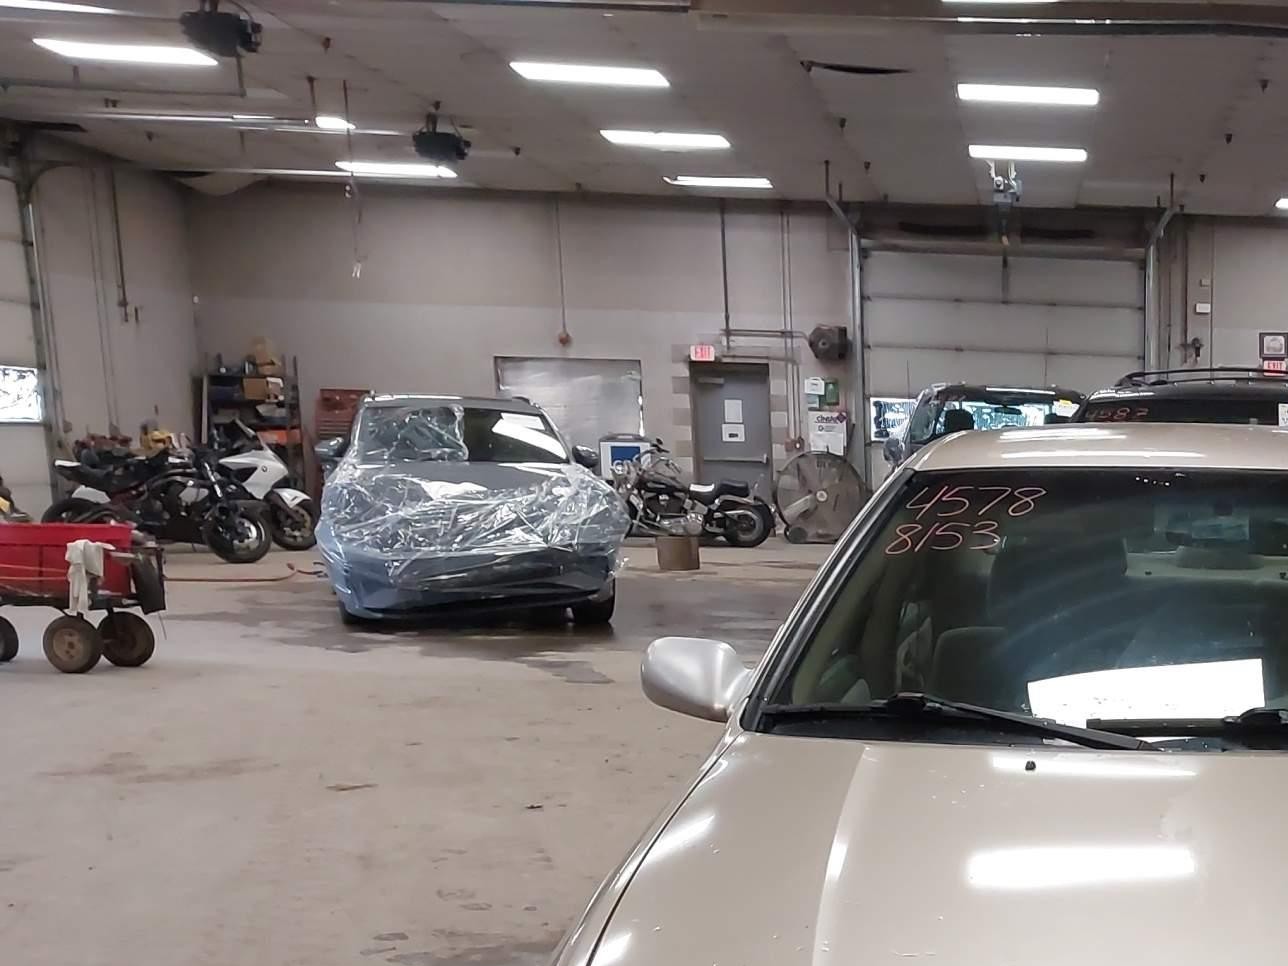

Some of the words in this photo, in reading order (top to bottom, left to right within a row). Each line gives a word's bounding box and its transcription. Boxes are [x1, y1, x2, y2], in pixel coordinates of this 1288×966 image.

[694, 345, 711, 359] EXIT
[1267, 361, 1283, 369] EXIT
[905, 485, 1048, 521] 4578
[885, 520, 1001, 555] 8153
